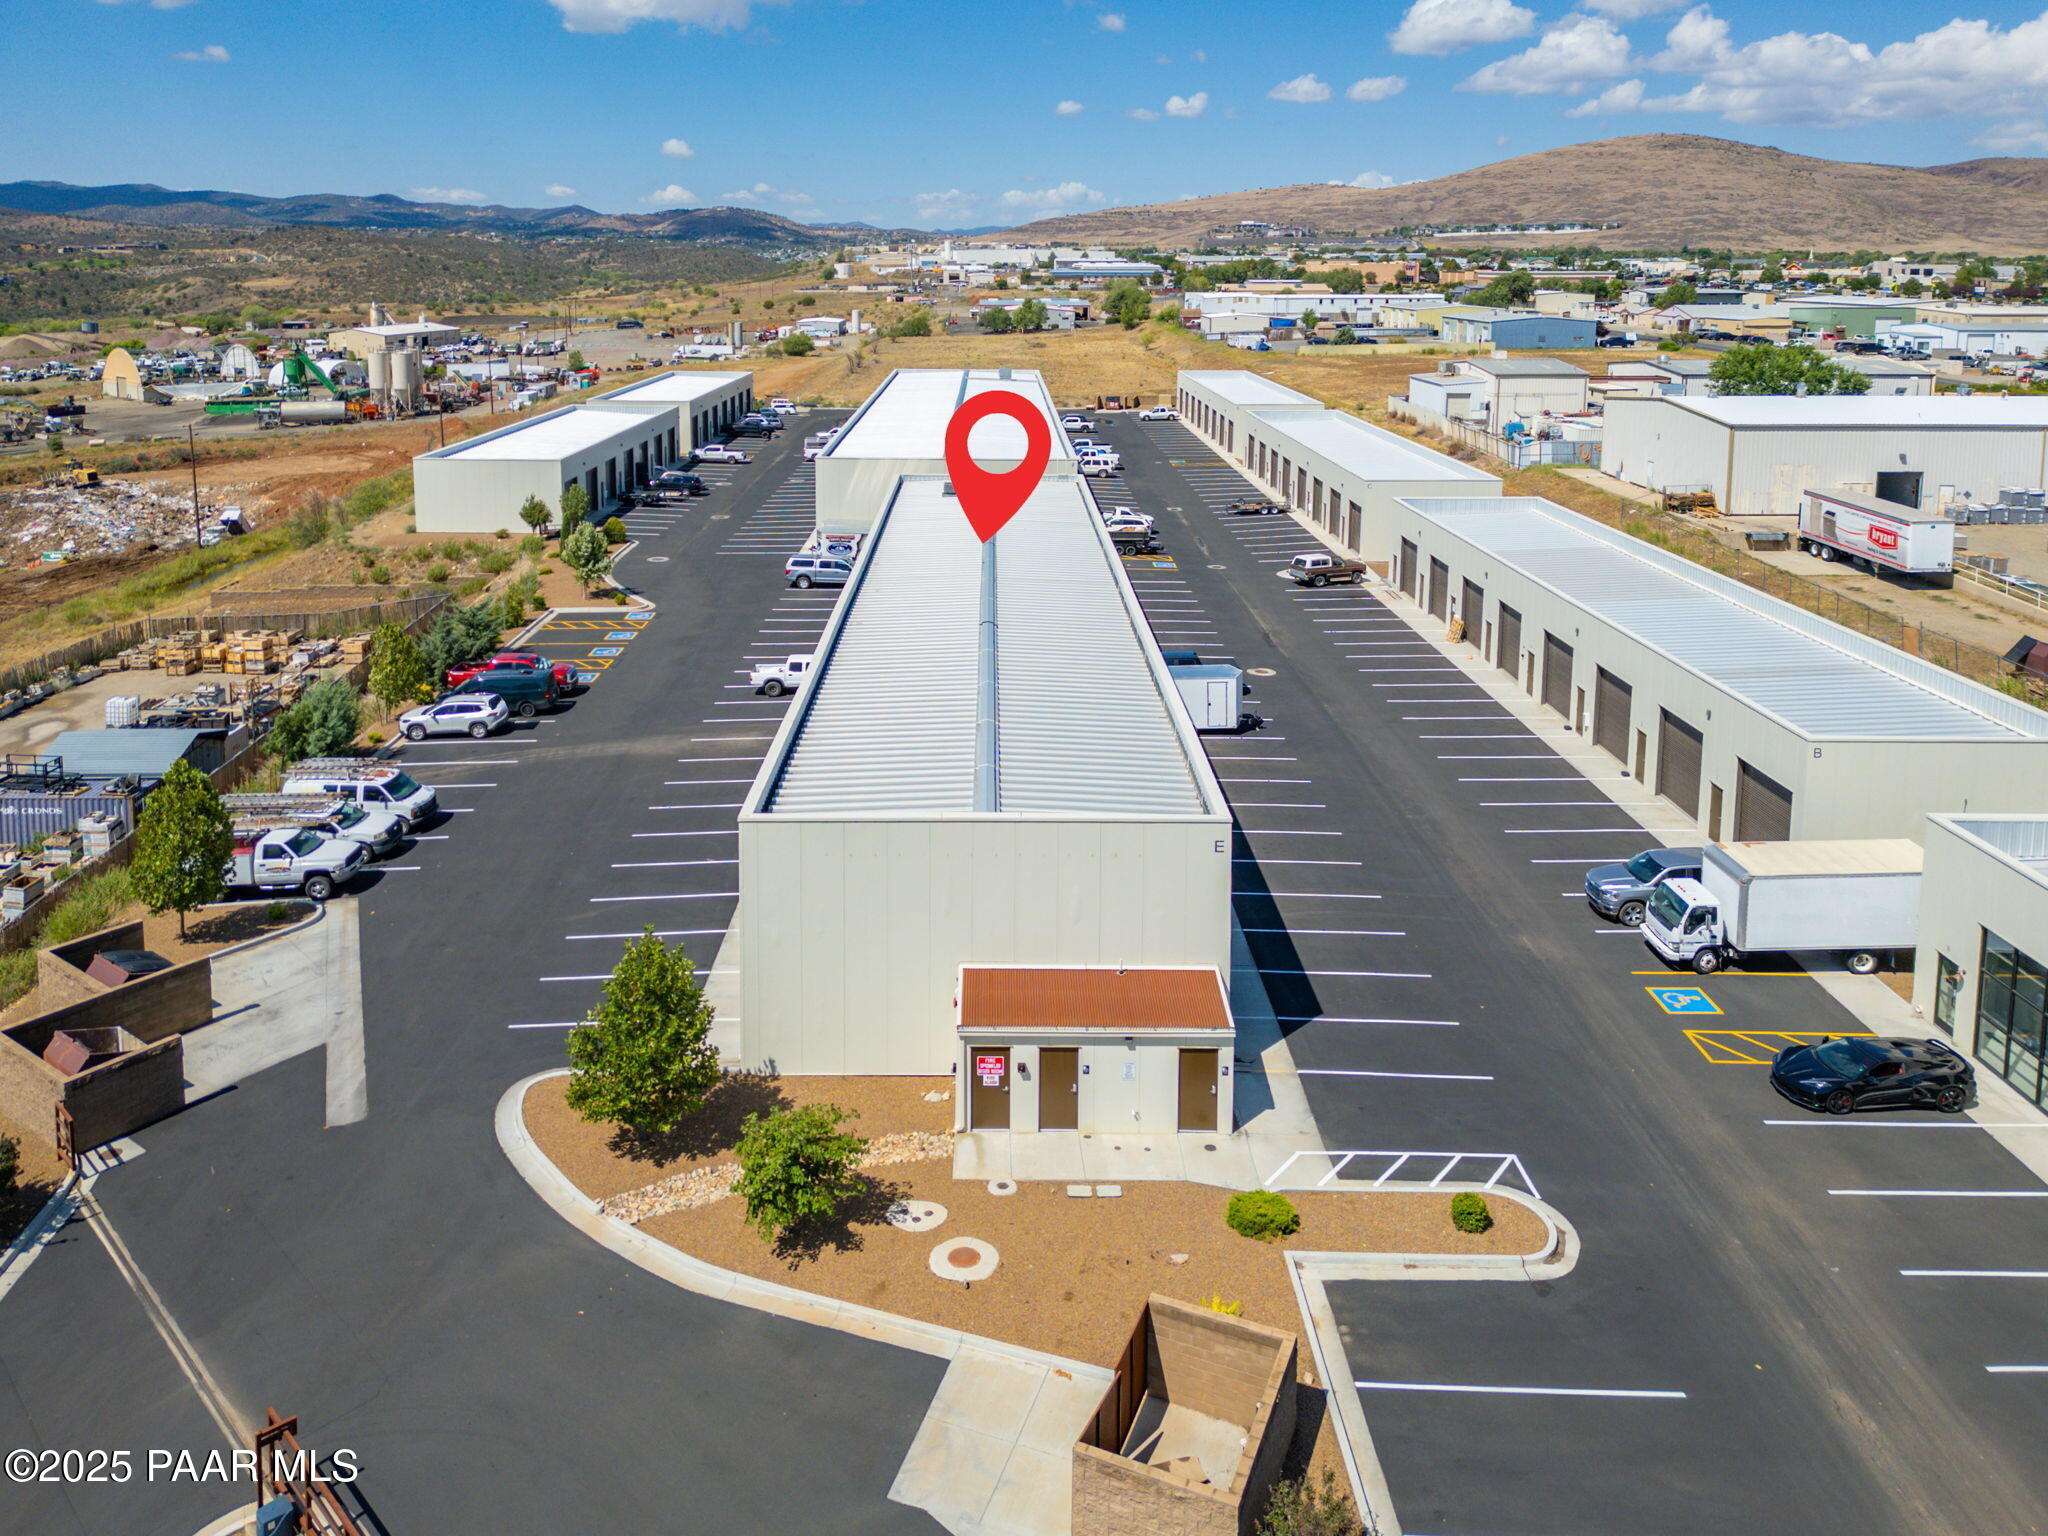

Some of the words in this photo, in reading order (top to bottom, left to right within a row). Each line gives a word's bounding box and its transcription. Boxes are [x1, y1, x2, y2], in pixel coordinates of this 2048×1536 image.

[1873, 528, 1895, 546] bryant
[1813, 747, 1822, 758] B
[21, 807, 63, 815] CRONOS
[1214, 840, 1224, 853] E
